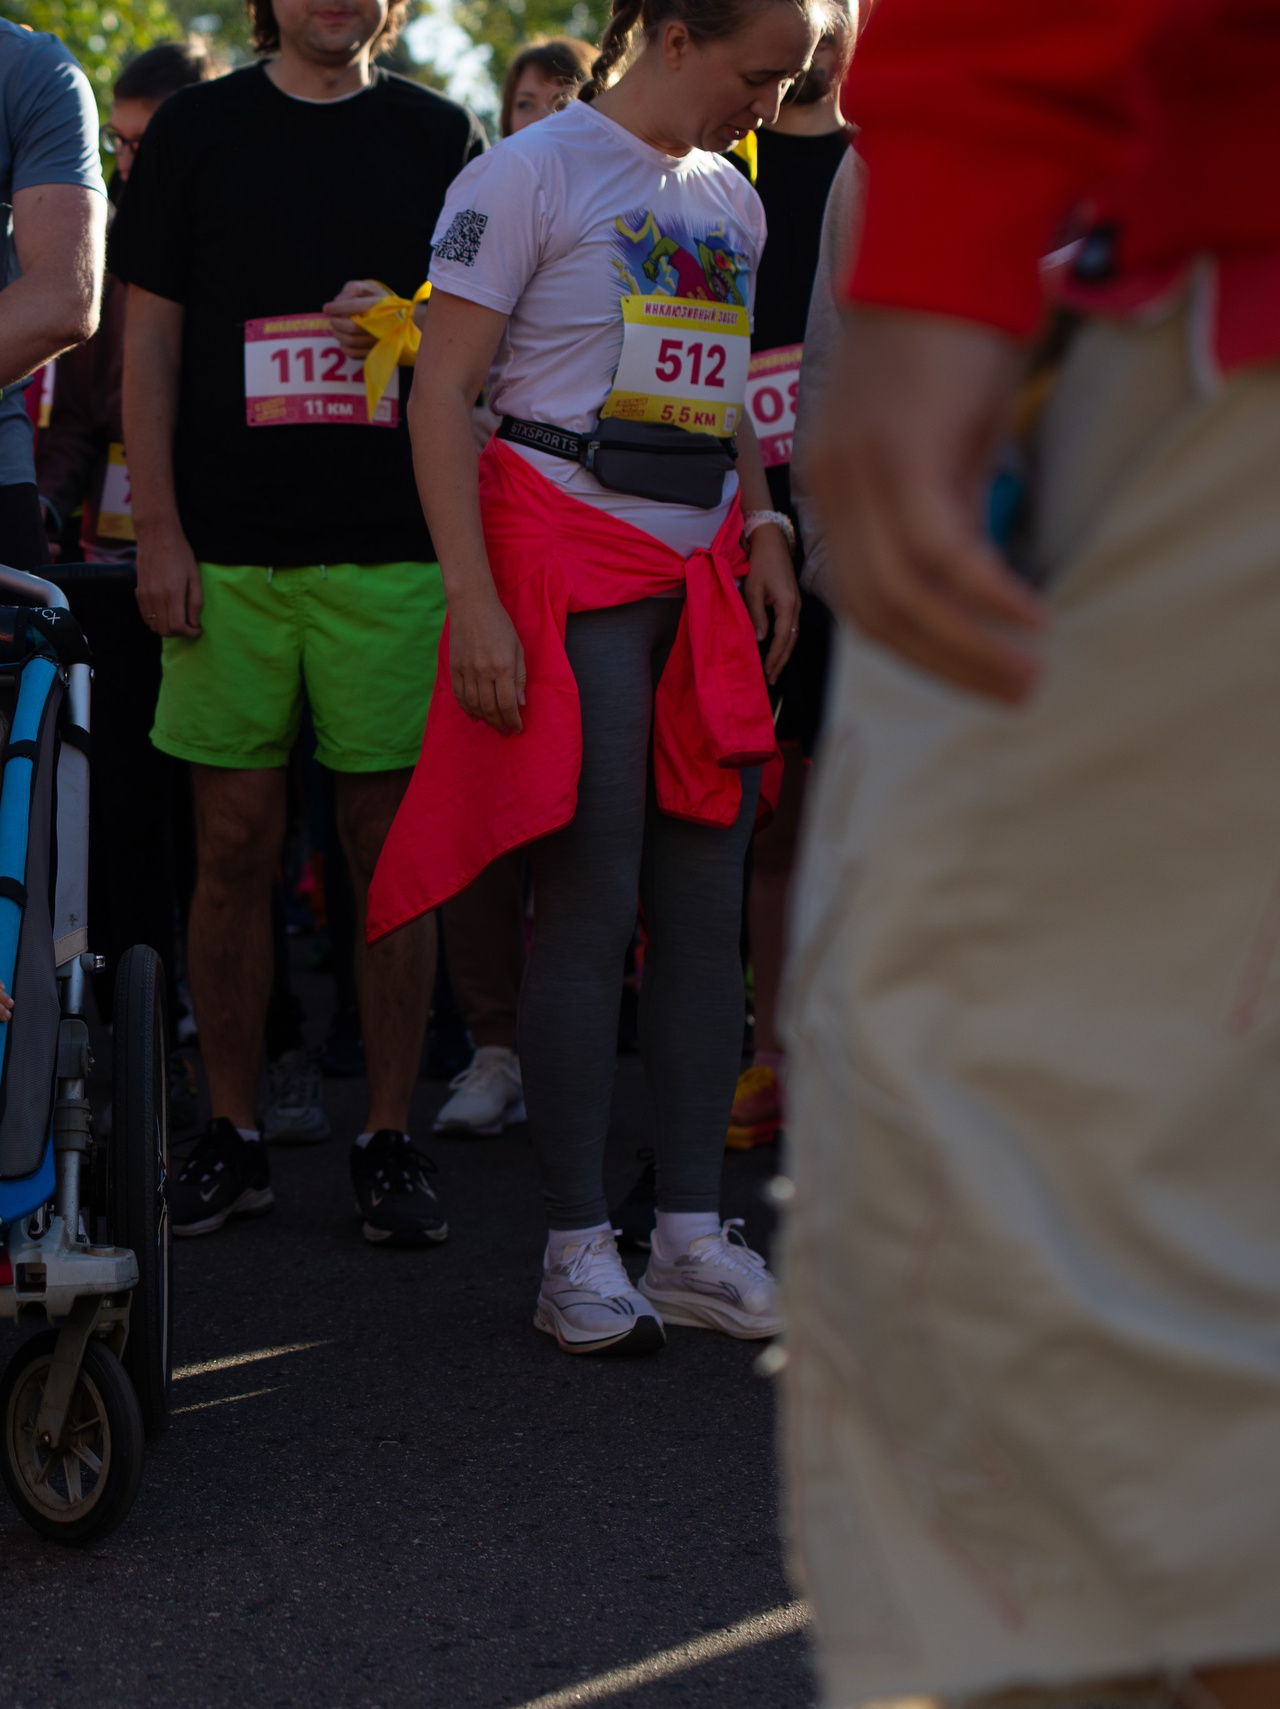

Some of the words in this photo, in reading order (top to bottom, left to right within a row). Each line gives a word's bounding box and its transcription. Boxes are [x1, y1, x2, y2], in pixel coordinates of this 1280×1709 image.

[656, 338, 726, 388] 512
[304, 399, 324, 415] 11
[661, 405, 691, 425] 5,5
